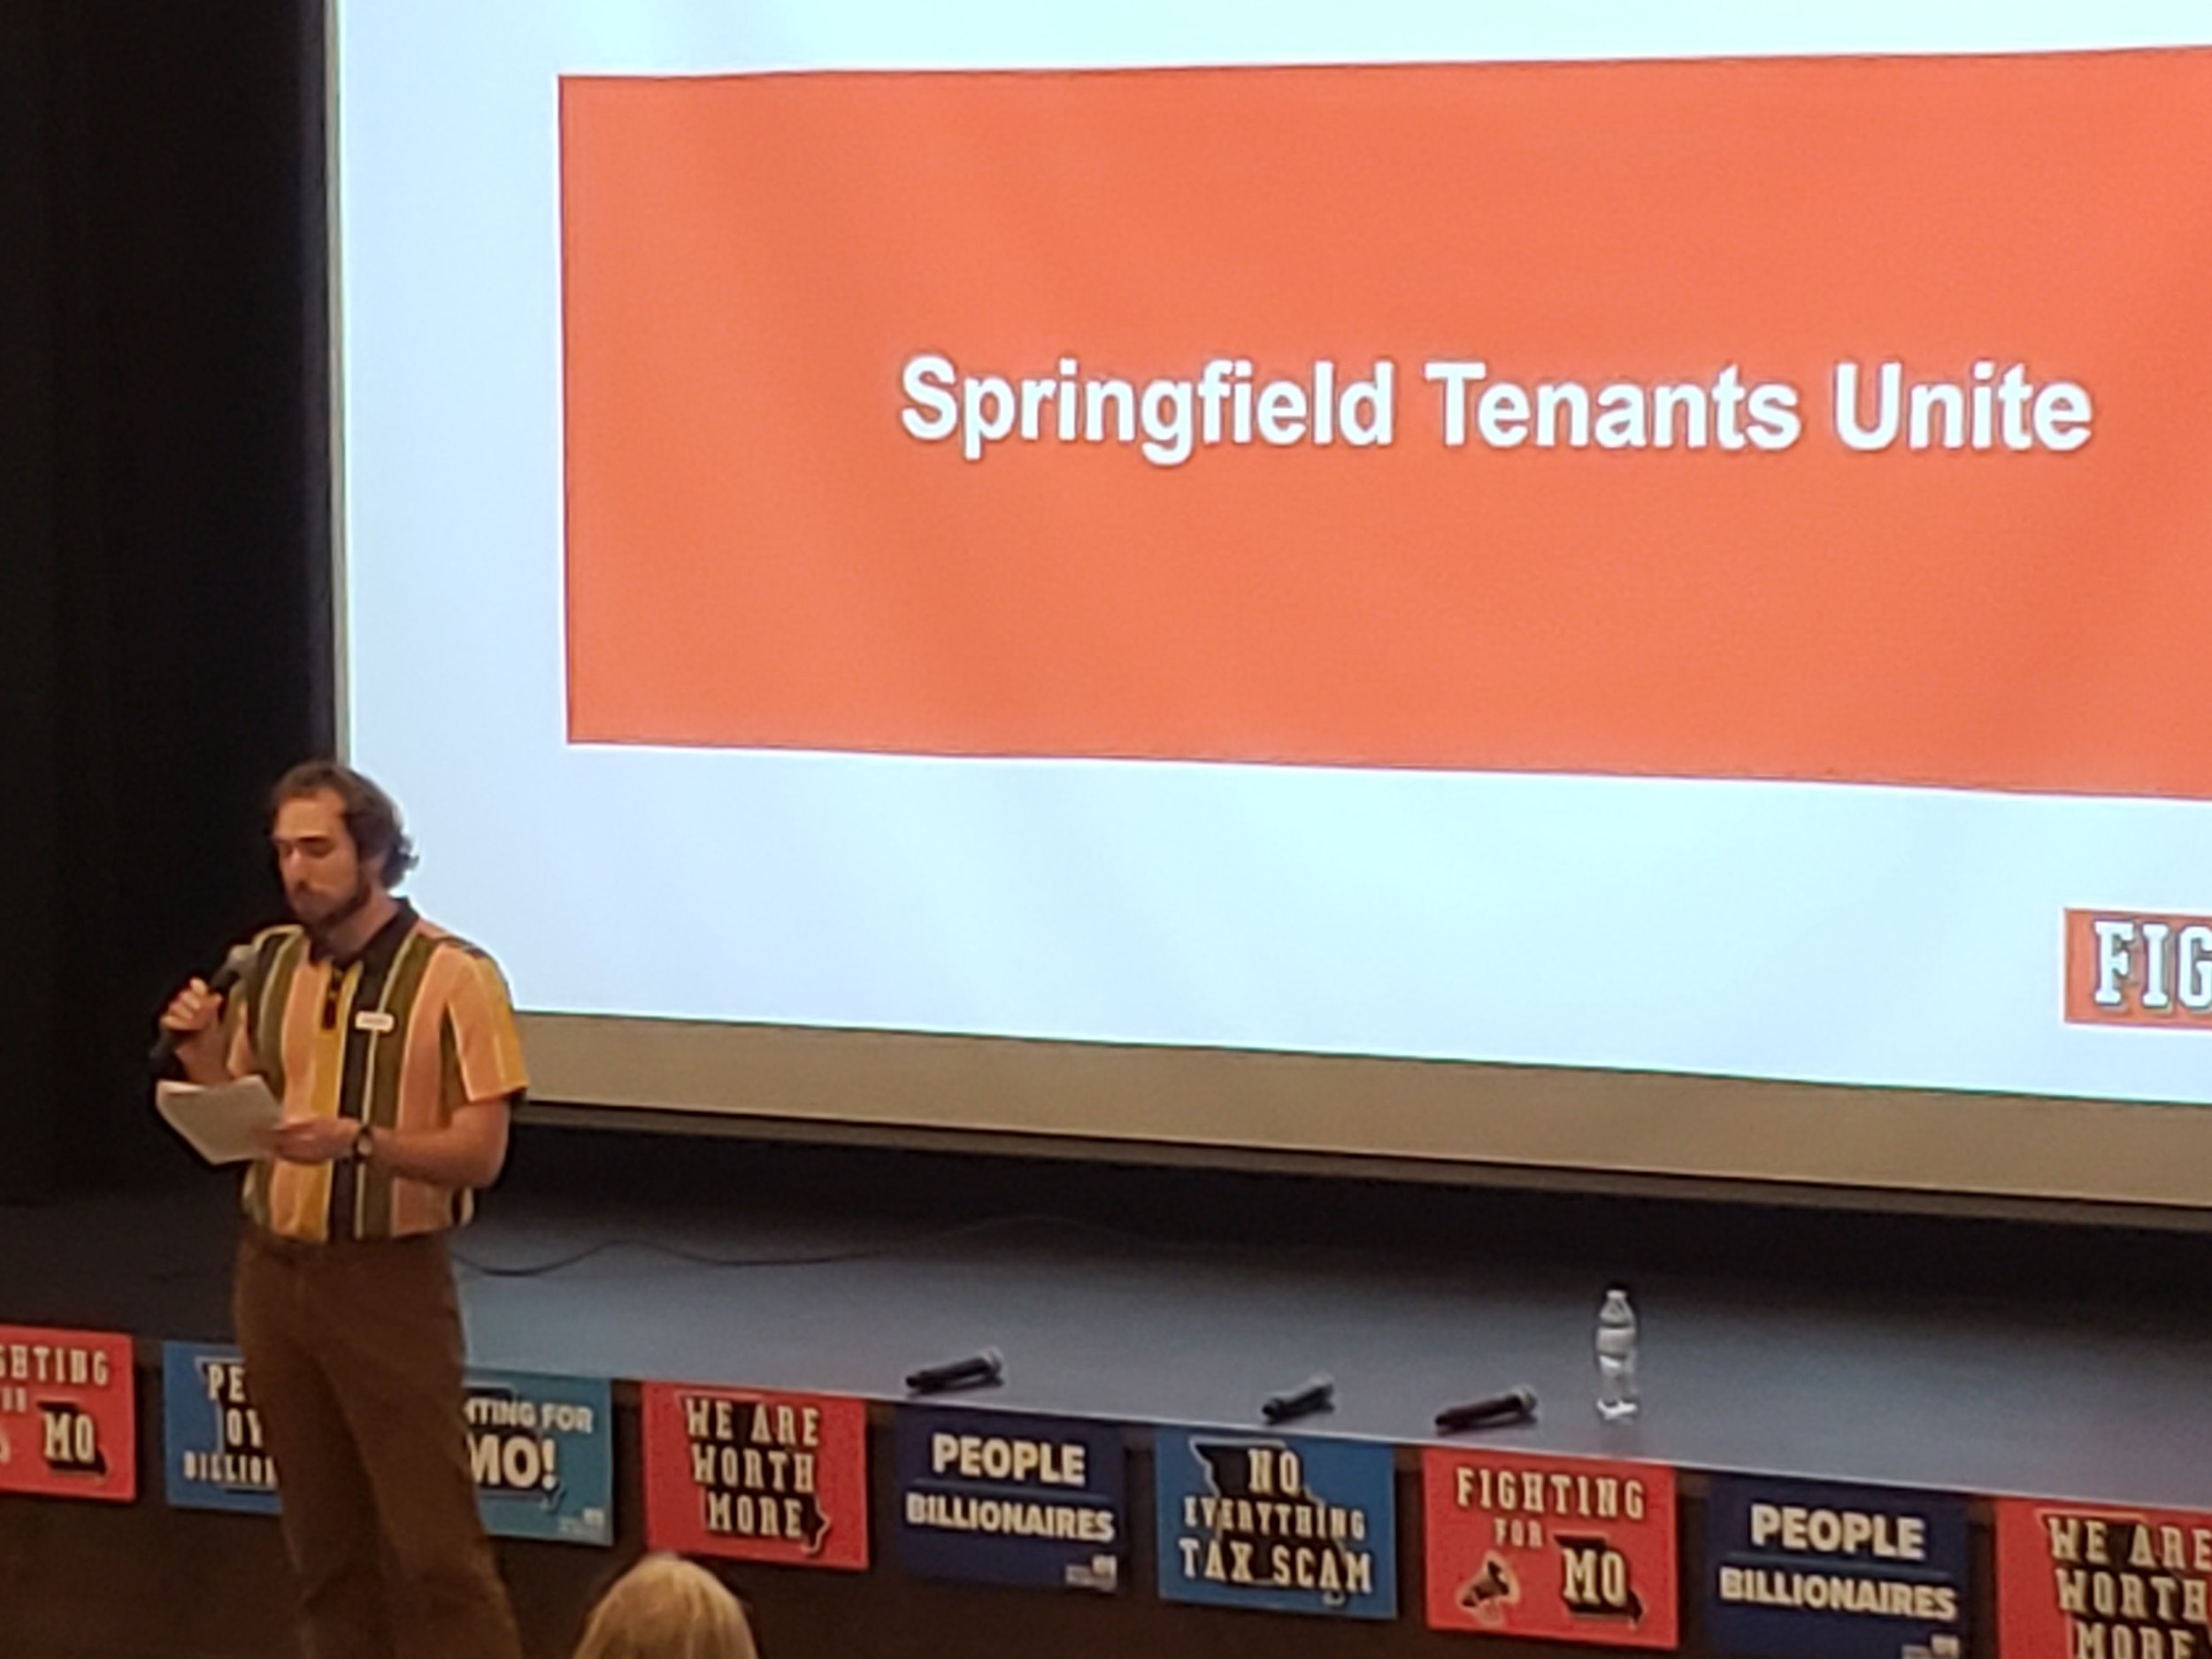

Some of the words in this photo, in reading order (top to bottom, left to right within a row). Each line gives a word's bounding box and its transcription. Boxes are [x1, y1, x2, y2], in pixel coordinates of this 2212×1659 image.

[901, 356, 1395, 465] Springfield
[1424, 360, 1801, 451] Tenants
[1833, 362, 2093, 451] Unite
[2093, 920, 2212, 1008] FIG
[44, 1412, 95, 1463] MO
[541, 1402, 594, 1433] FOR
[686, 1397, 733, 1440] WE
[750, 1403, 819, 1448] ARE
[692, 1443, 815, 1494] WORTH
[932, 1432, 1086, 1487] PEOPLE
[1248, 1448, 1301, 1496] NO
[708, 1492, 803, 1539] MORE
[905, 1491, 1116, 1543] BILLIONAIRES
[1183, 1495, 1365, 1540] EVERYTHING
[1456, 1466, 1645, 1520] FIGHTING
[1494, 1518, 1543, 1548] FOR
[1751, 1503, 1925, 1561] PEOPLE
[2048, 1517, 2109, 1565] WE
[2129, 1524, 2212, 1571] ARE
[1179, 1536, 1254, 1584] TAX
[1271, 1545, 1371, 1594] SCAM
[1563, 1548, 1626, 1608] MO
[1719, 1566, 1958, 1622] BILLIONAIRES
[2055, 1568, 2208, 1622] WORTH
